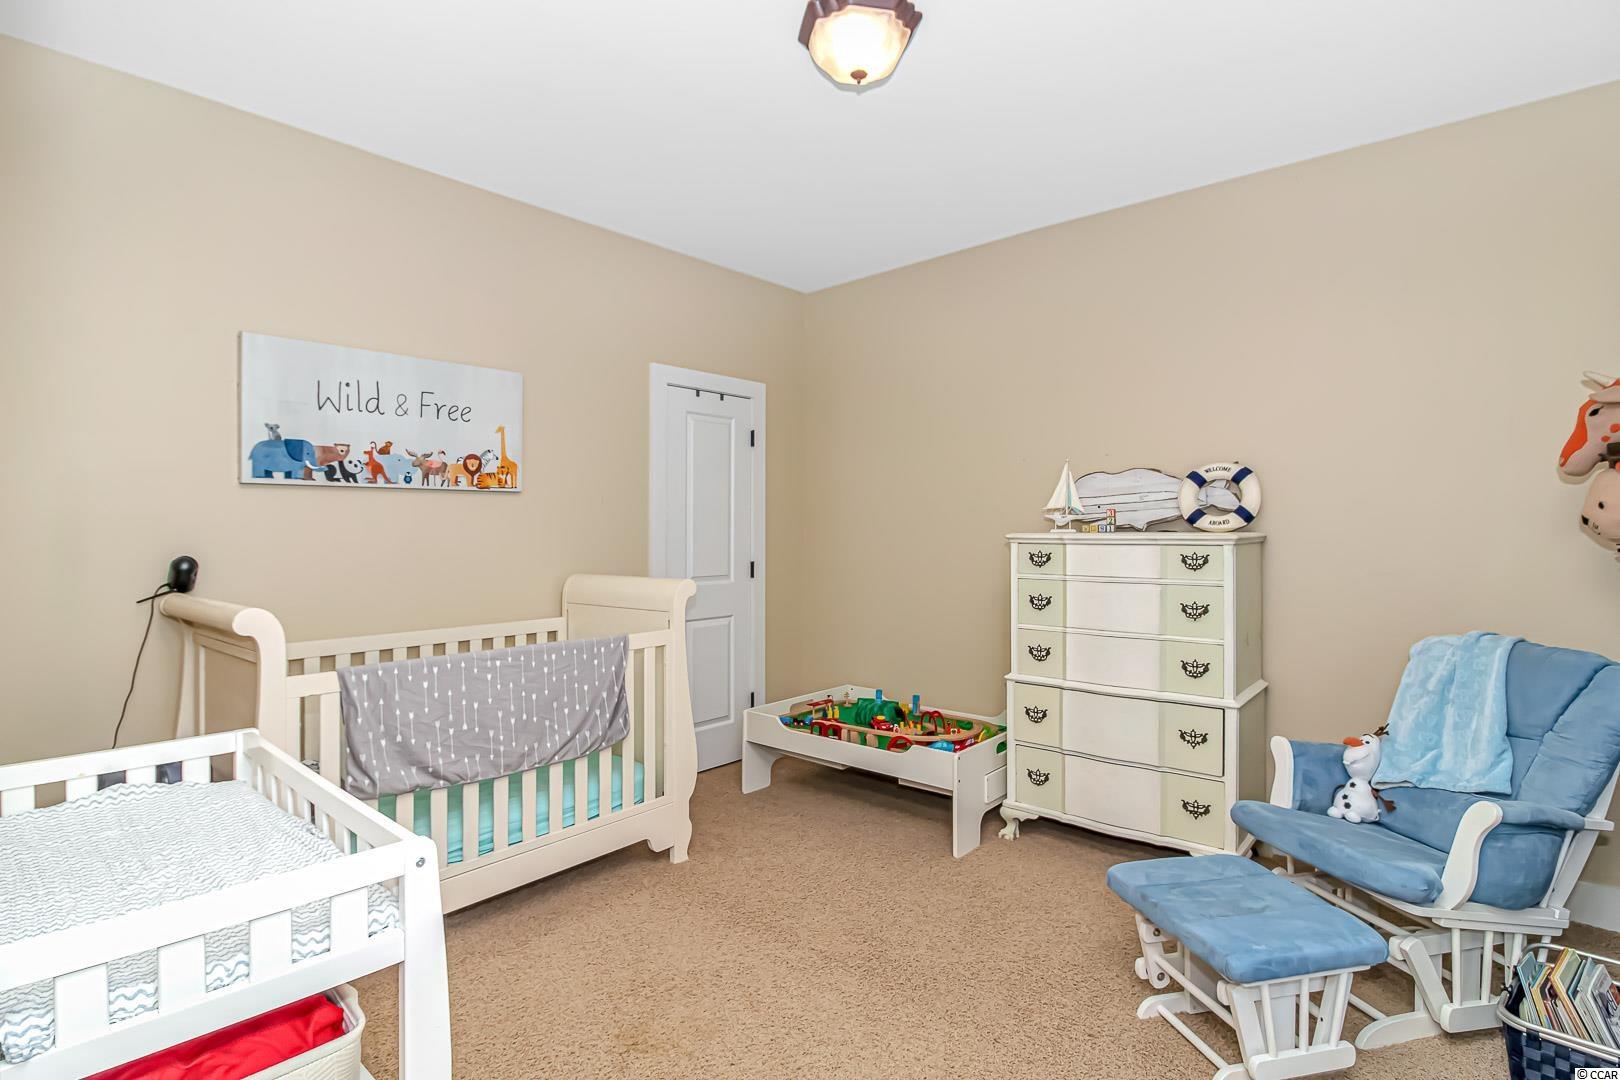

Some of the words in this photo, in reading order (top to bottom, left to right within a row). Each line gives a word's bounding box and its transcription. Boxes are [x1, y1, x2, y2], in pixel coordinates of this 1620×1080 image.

[317, 379, 386, 416] Wild
[394, 393, 409, 417] &
[419, 391, 472, 423] Free
[1204, 465, 1232, 474] WELCOME
